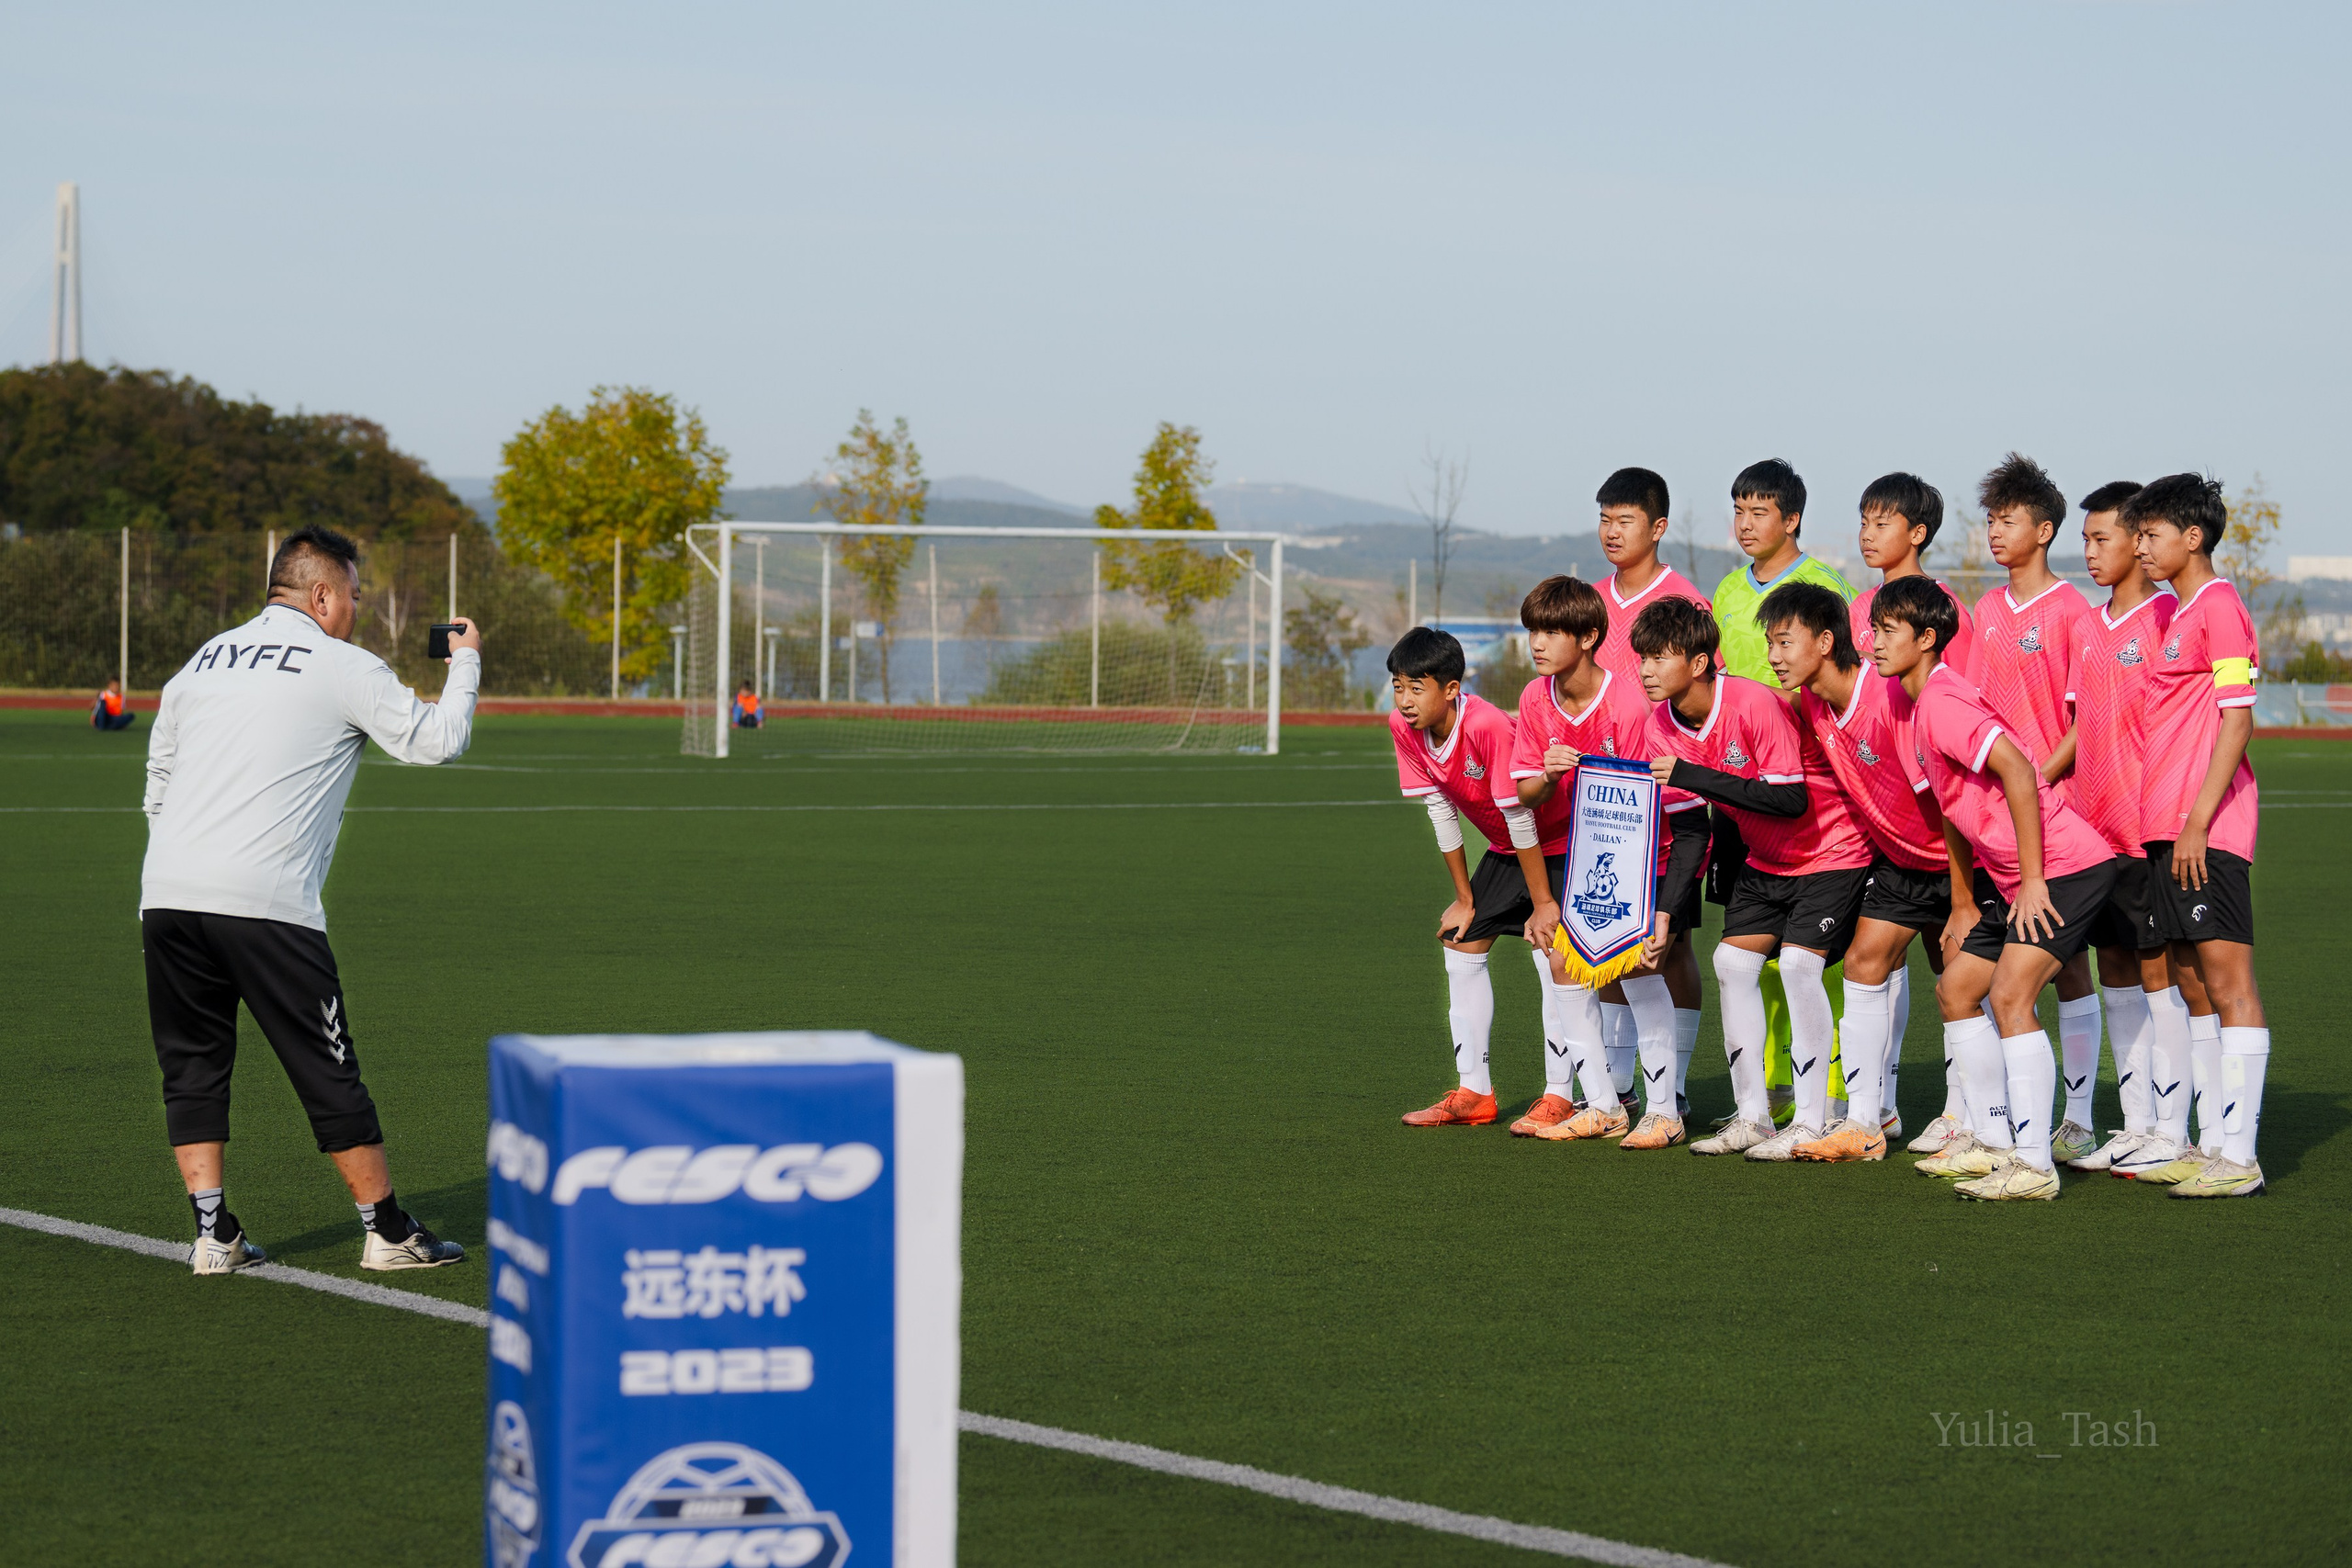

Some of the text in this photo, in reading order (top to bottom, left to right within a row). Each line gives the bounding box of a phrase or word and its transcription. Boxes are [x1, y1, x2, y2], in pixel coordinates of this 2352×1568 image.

[195, 644, 312, 674] HYFC
[1588, 784, 1638, 807] CHINA
[1593, 832, 1622, 844] DALIAN
[1598, 822, 1622, 830] FOOTBALL
[551, 1142, 883, 1206] FESCO
[621, 1245, 807, 1319] 远东杯
[620, 1347, 814, 1396] 2023
[596, 1527, 824, 1568] FESCO
